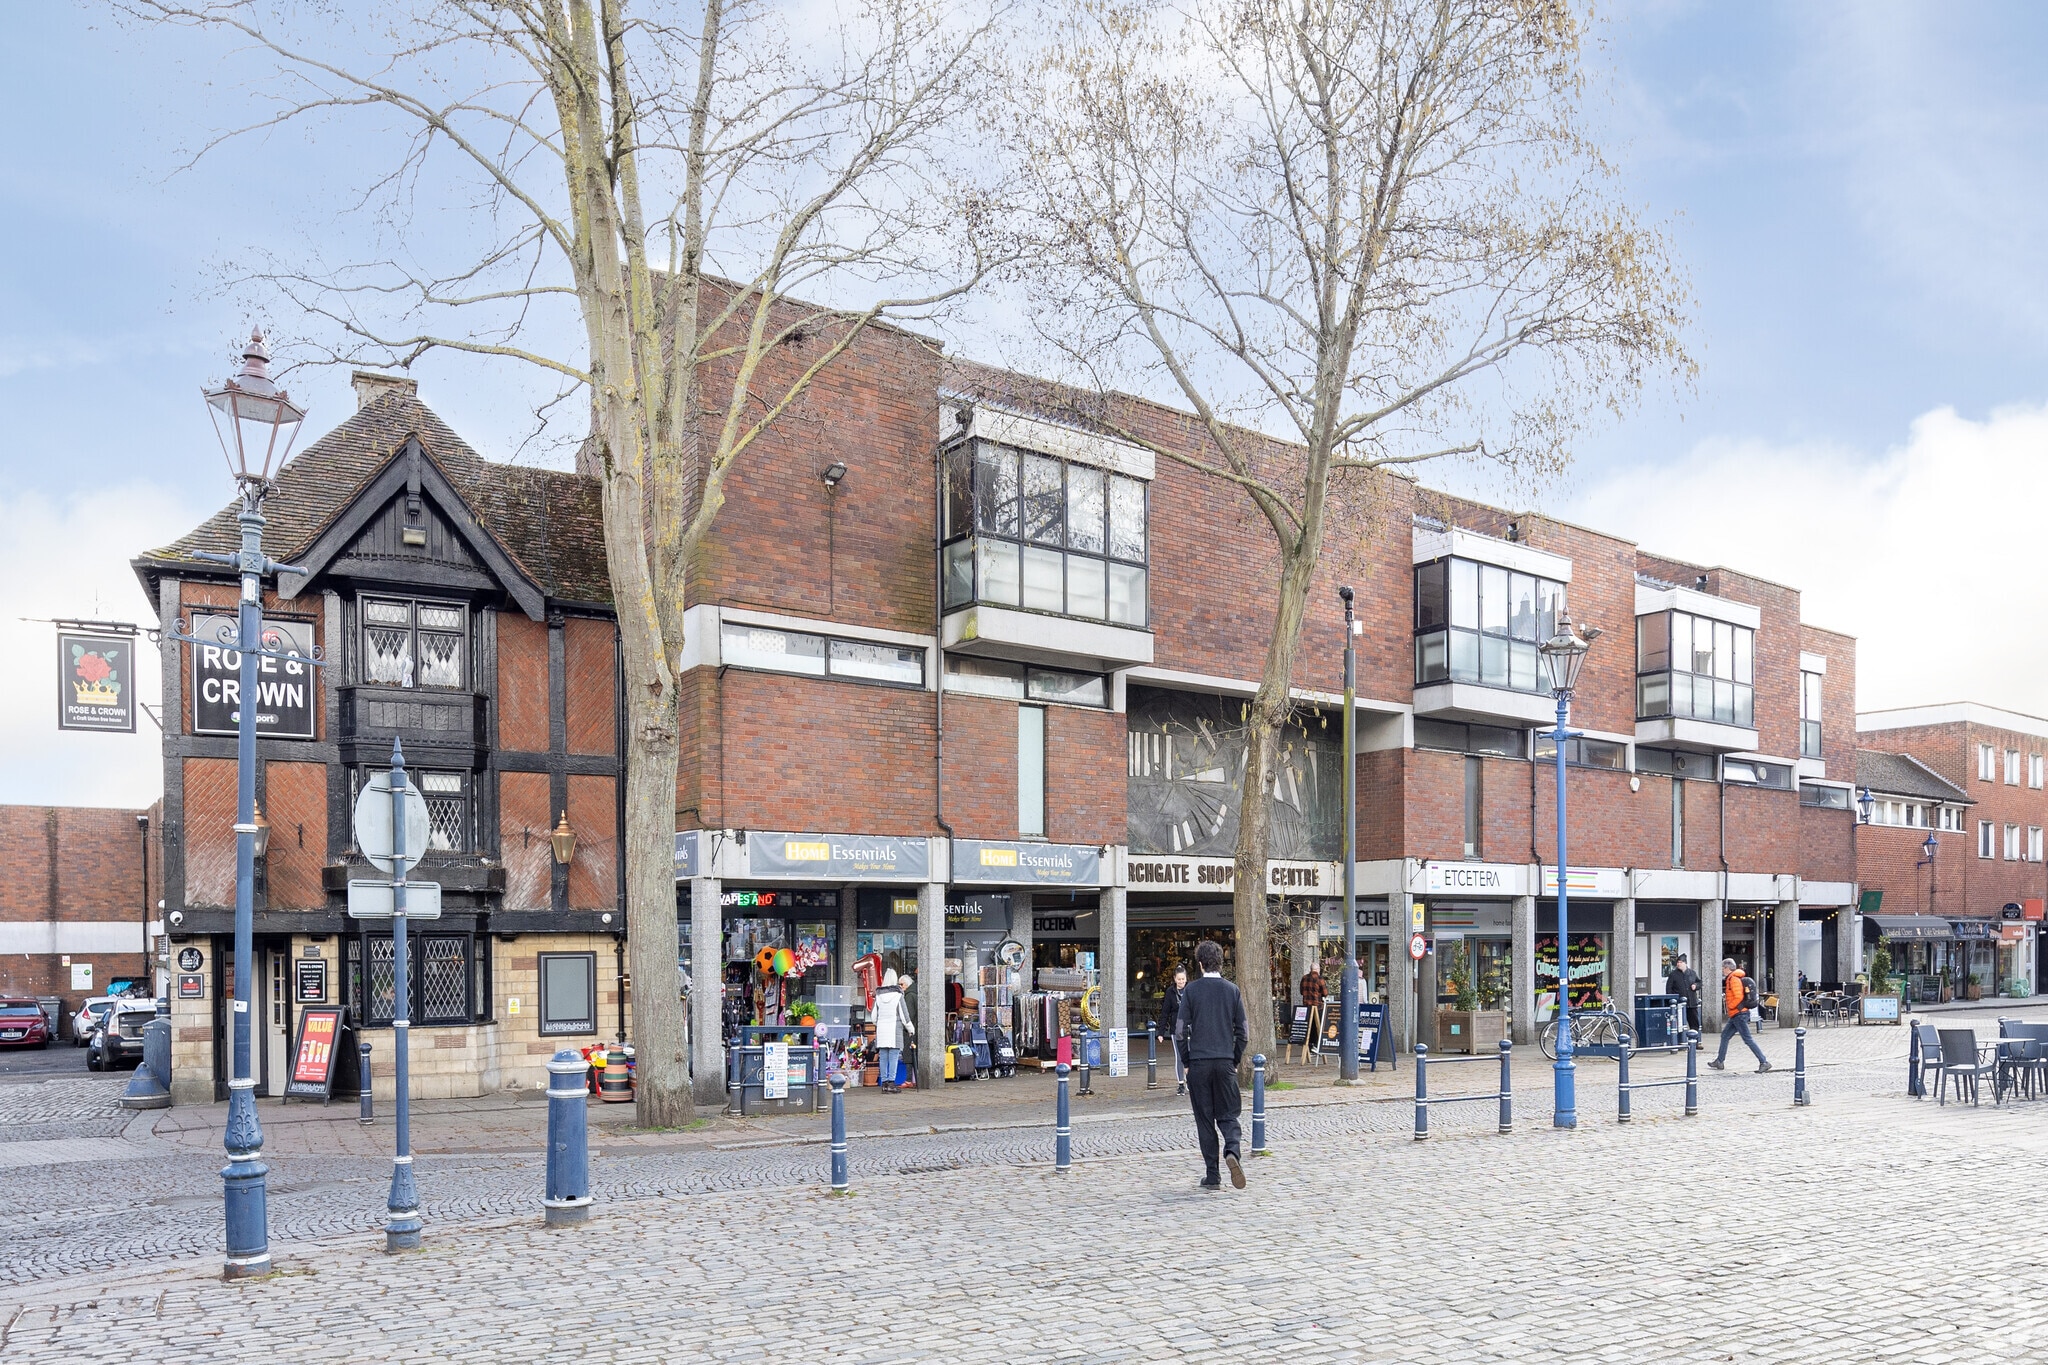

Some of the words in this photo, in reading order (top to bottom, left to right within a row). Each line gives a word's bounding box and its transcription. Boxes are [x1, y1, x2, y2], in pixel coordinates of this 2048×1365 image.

[203, 644, 278, 673] ROE
[285, 650, 304, 675] &
[202, 678, 304, 708] CRWN
[68, 705, 90, 715] ROSE
[90, 706, 97, 715] &
[97, 707, 127, 717] CROWN
[1197, 864, 1234, 885] SHOP
[1272, 867, 1319, 887] CENTRE
[1445, 869, 1501, 887] ETCETERA
[751, 894, 773, 905] AND
[307, 1021, 333, 1033] VALUE
